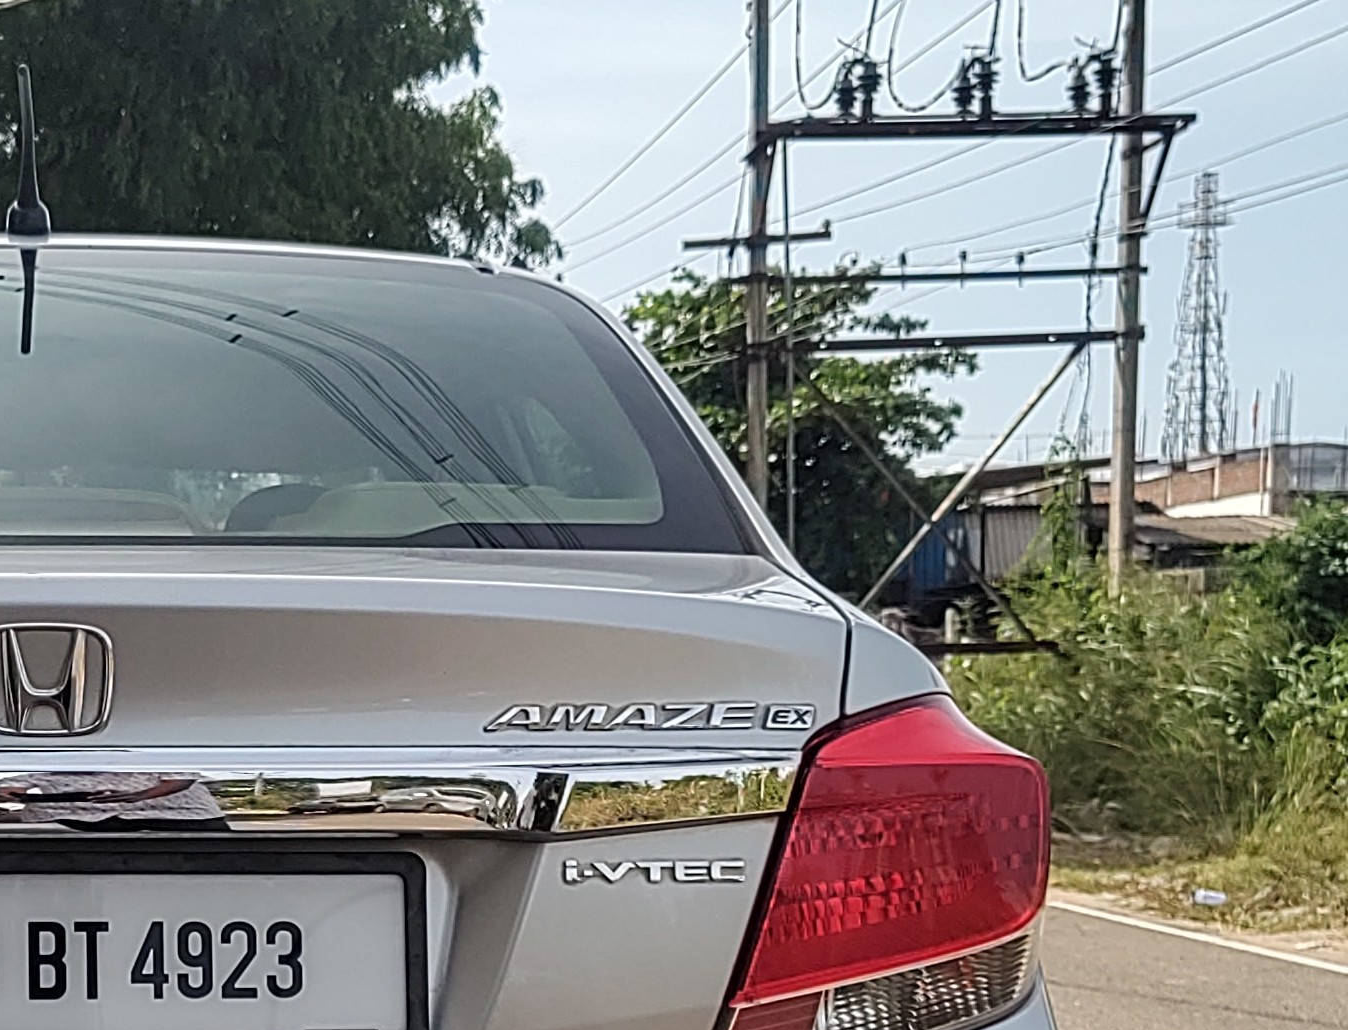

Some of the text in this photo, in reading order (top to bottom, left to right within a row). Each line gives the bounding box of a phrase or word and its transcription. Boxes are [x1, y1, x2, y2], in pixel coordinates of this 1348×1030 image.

[483, 702, 813, 732] AMAZE EX
[27, 921, 109, 1000] BT
[130, 920, 303, 999] 4923
